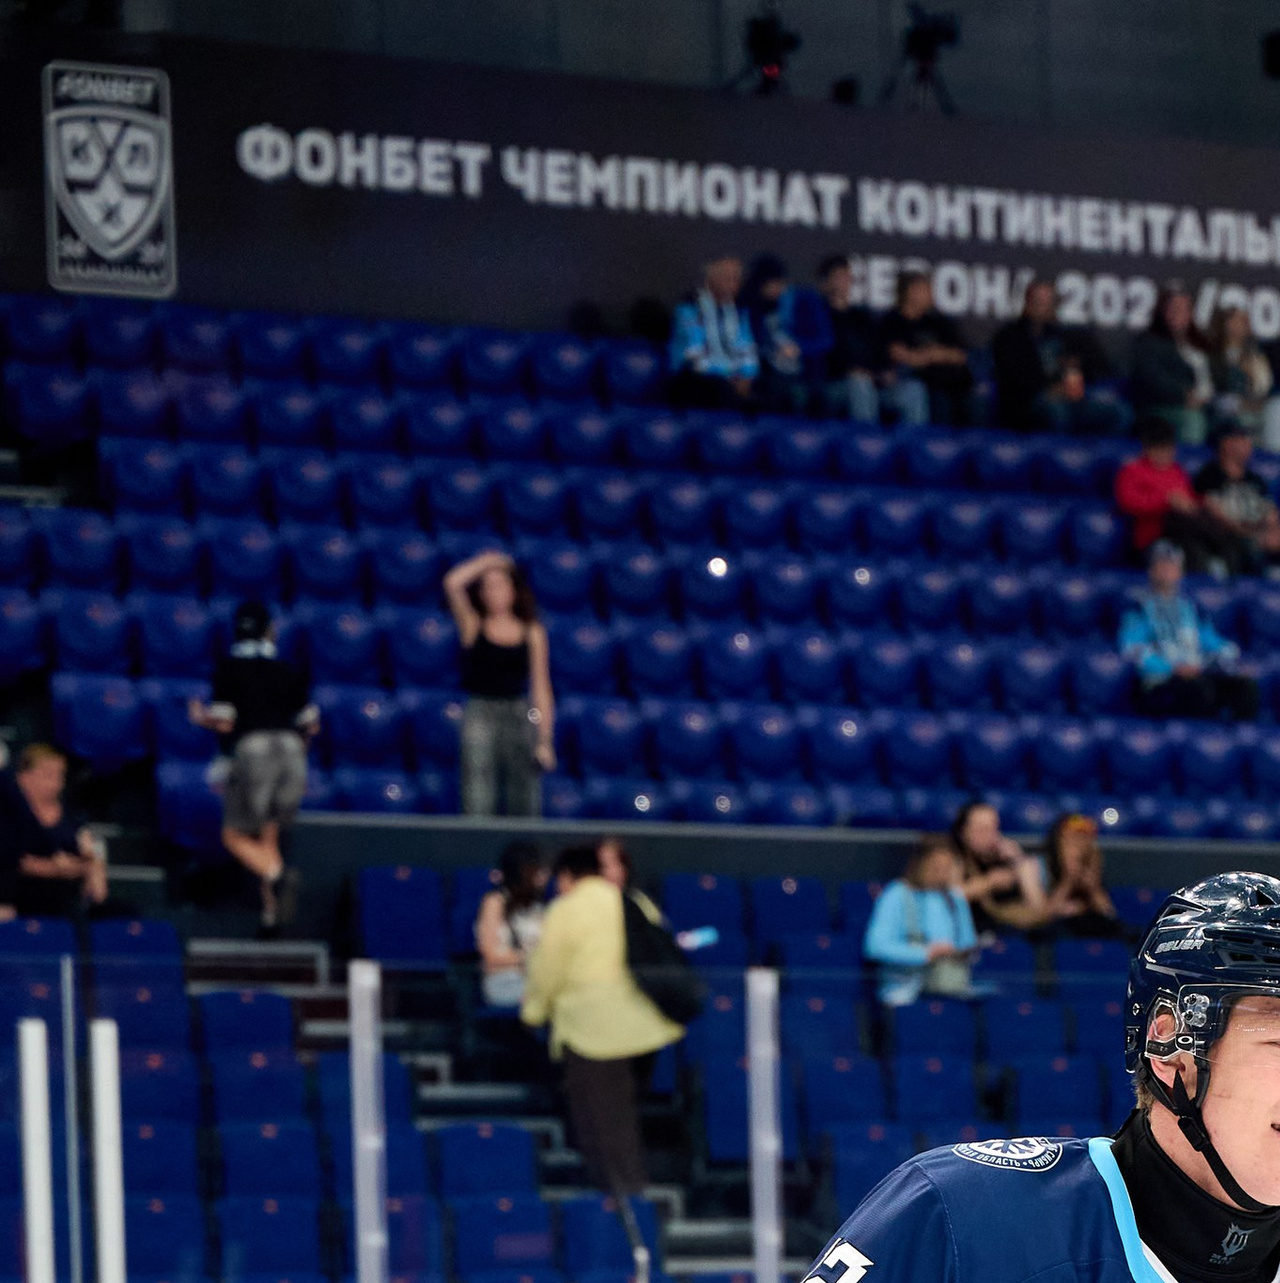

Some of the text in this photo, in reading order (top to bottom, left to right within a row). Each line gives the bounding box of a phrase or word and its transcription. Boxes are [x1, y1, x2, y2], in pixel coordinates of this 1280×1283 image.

[236, 122, 492, 198] ФОНБЕТ
[500, 146, 851, 230] ЧЕМПИОНАТ
[976, 1152, 1021, 1167] ОБЛАСТЬ
